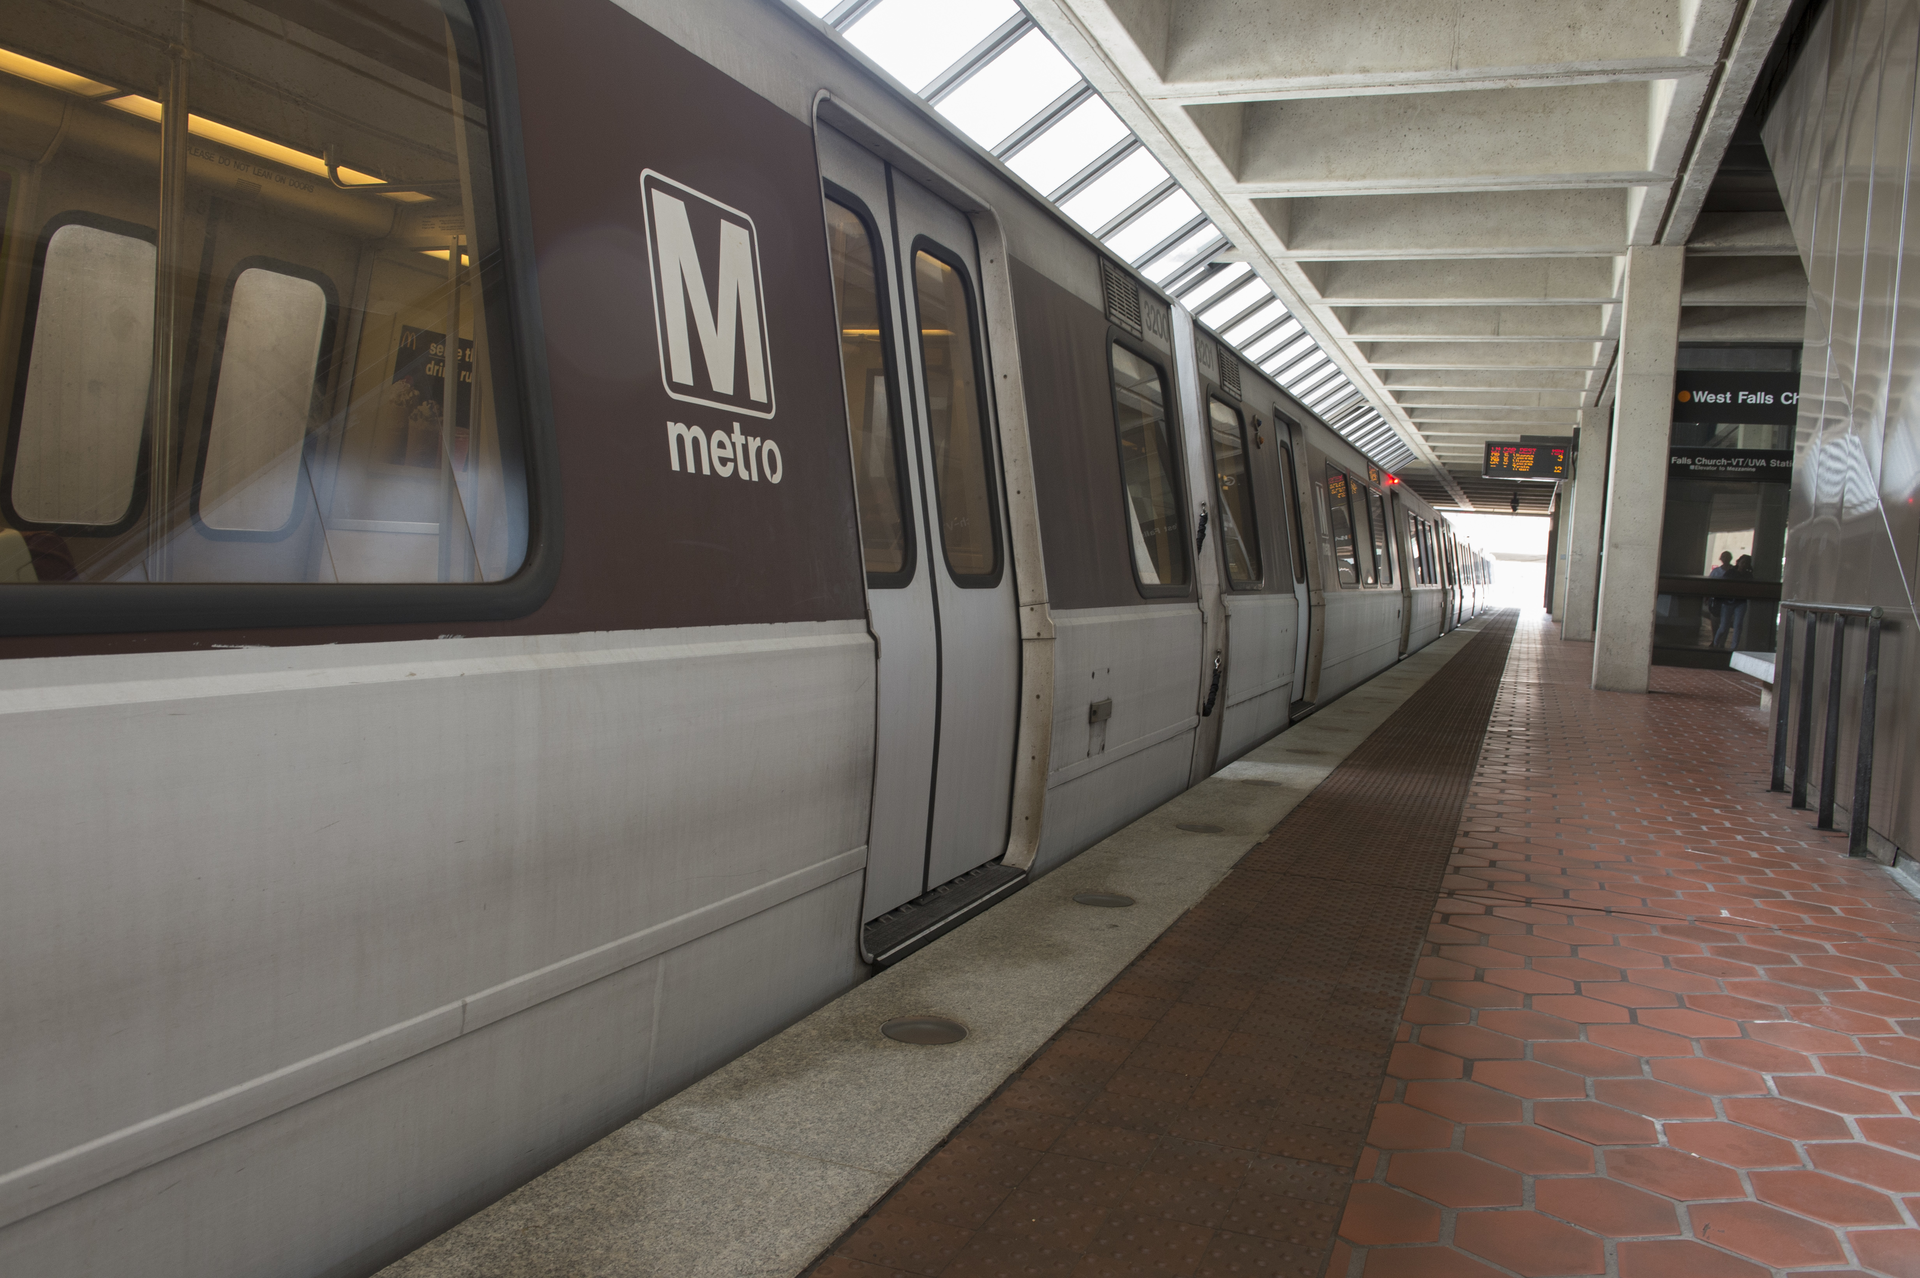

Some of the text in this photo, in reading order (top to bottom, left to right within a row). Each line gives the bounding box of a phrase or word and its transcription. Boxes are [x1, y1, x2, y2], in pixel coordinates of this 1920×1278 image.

[218, 155, 231, 167] DO
[233, 161, 250, 173] NOT
[253, 167, 273, 180] LEAN
[274, 174, 287, 184] ON
[289, 178, 315, 193] DOORS
[651, 187, 768, 404] M
[1693, 391, 1732, 403] West
[1738, 391, 1774, 404] Falls
[667, 421, 783, 484] metro
[1671, 456, 1692, 465] Falls
[1695, 457, 1766, 467] Church-VT/UVA
